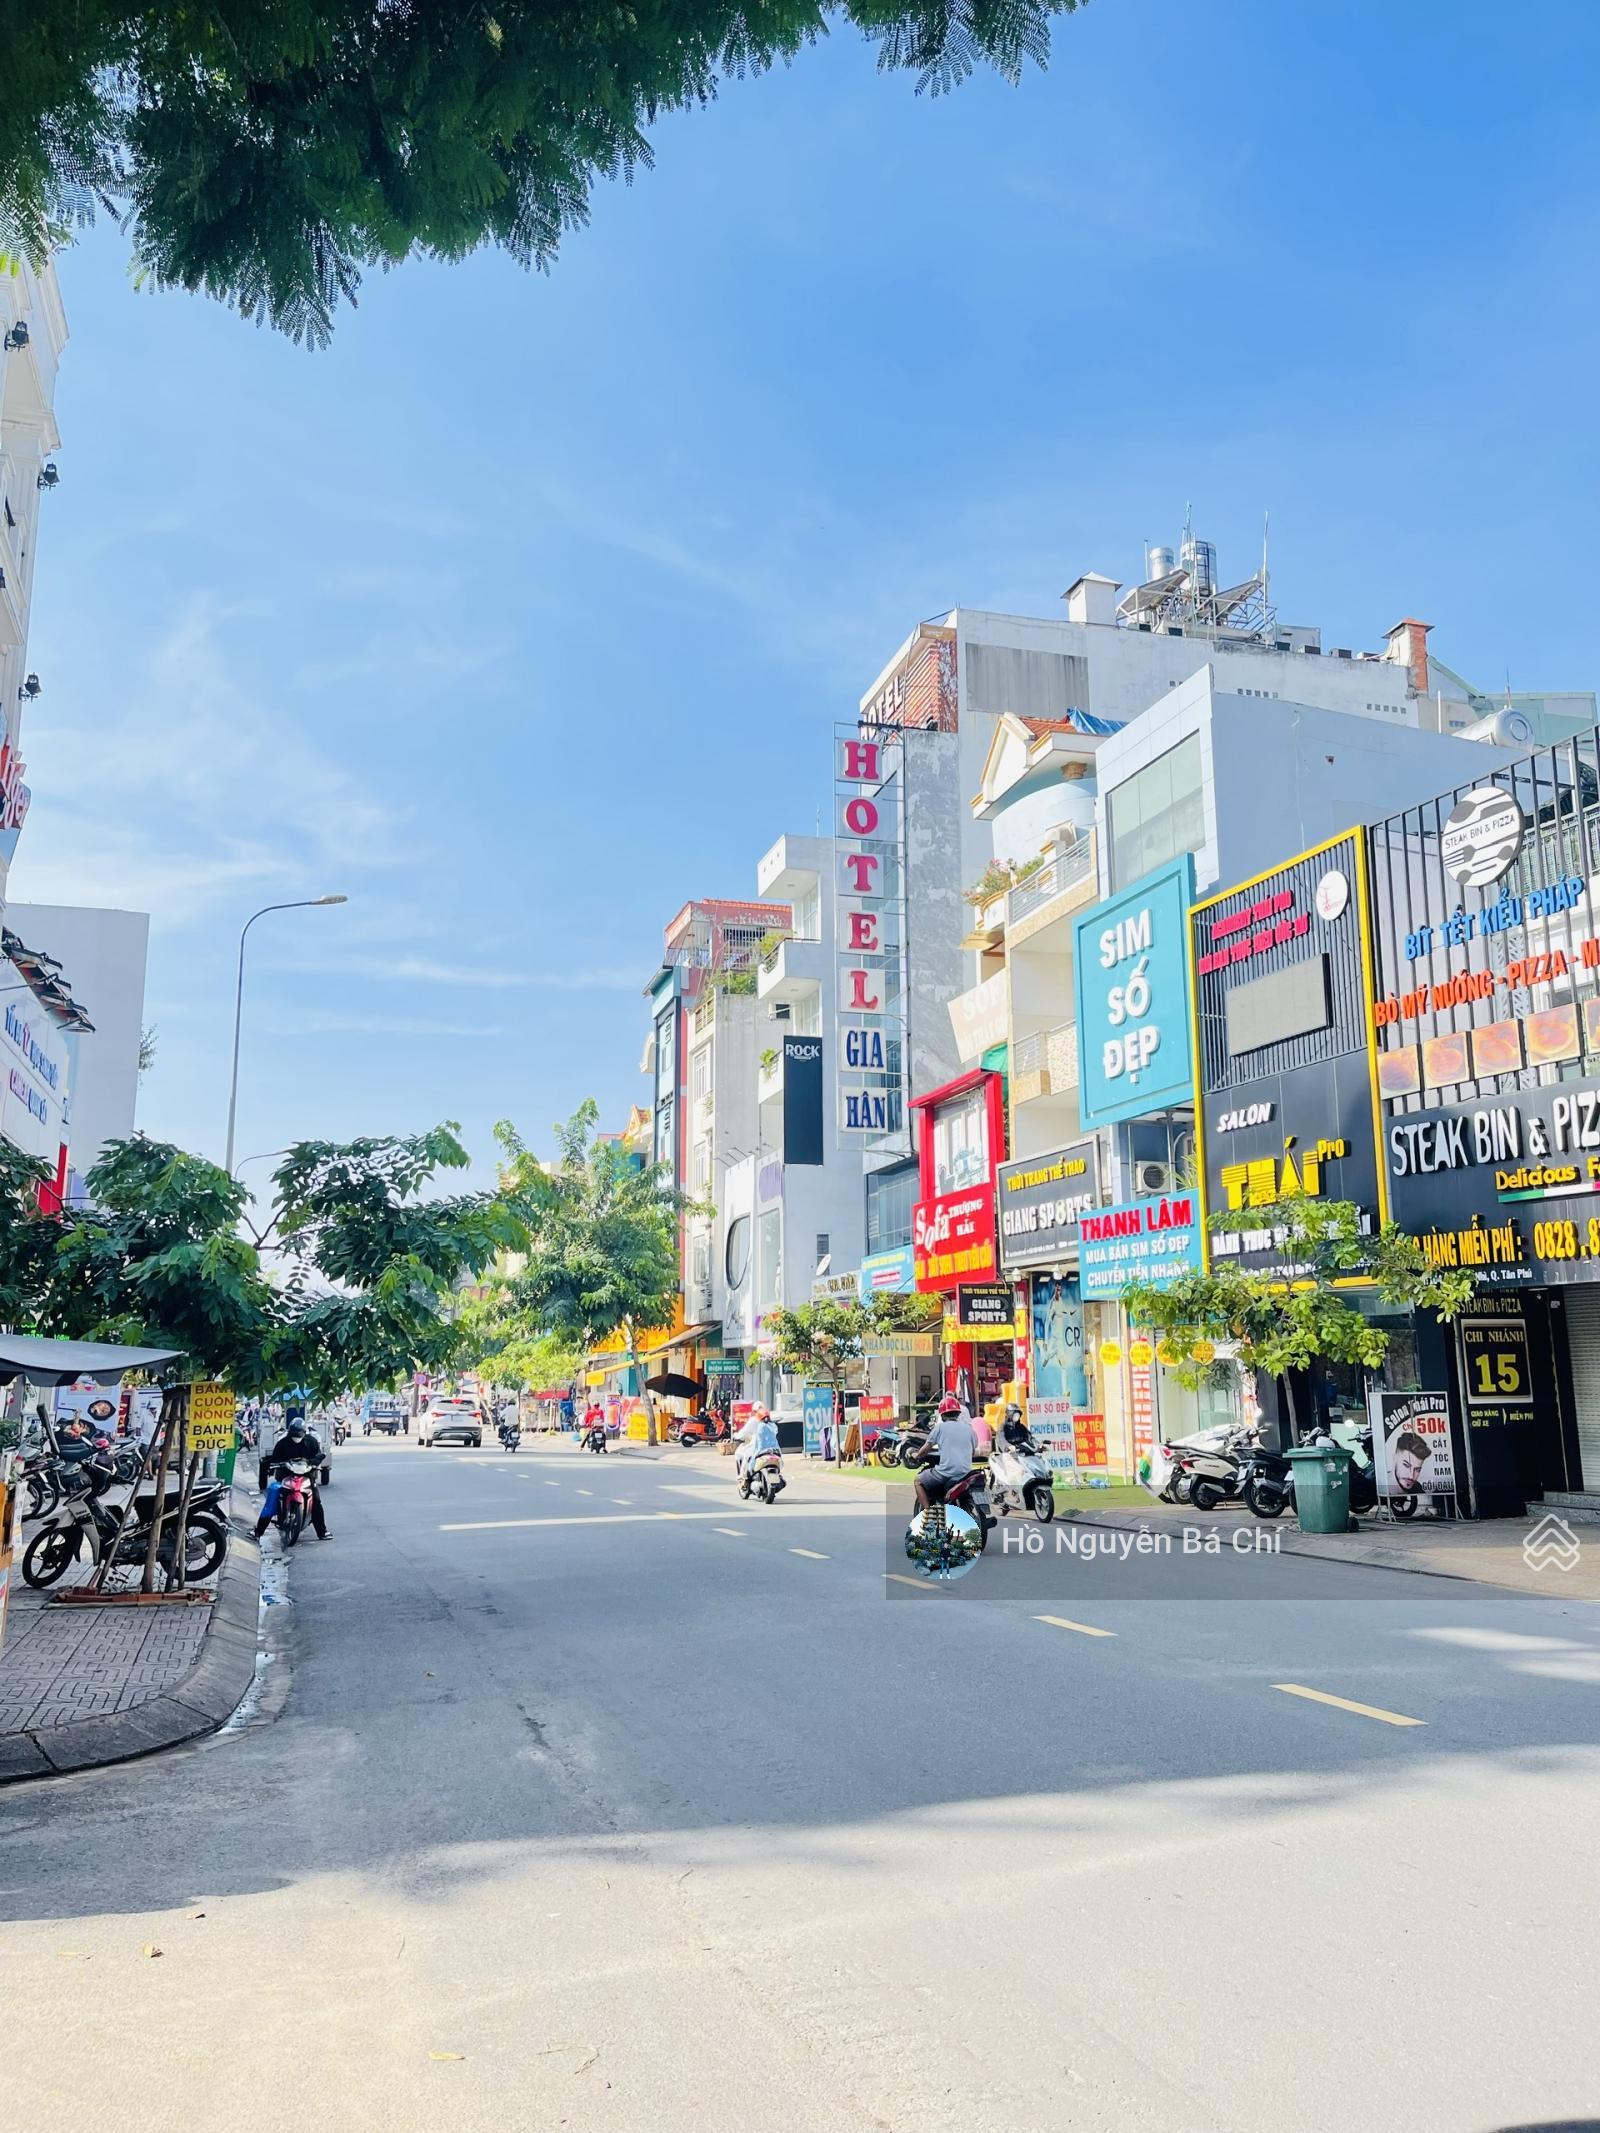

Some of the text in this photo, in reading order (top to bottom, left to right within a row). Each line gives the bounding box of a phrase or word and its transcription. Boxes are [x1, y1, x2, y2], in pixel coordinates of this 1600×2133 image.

[1445, 833, 1468, 849] STEAK
[1470, 828, 1484, 840] BIN
[1492, 814, 1516, 832] PIZZA
[844, 741, 879, 1010] HOTEL
[1404, 924, 1433, 961] BÍT
[1480, 888, 1525, 936] KIỂU
[1528, 874, 1585, 920] PHÁP
[1099, 908, 1152, 968] SIM
[1107, 955, 1151, 1025] SỐ
[1374, 992, 1399, 1027] BÒ
[1432, 968, 1494, 1012] NƯỚNG
[1507, 949, 1568, 991] PIZZA
[785, 1044, 820, 1057] ROCK
[846, 1030, 884, 1068] GIA
[1103, 1025, 1160, 1084] ĐẸP
[846, 1091, 885, 1129] HÂN
[1217, 1102, 1273, 1133] SALON
[1391, 1089, 1600, 1176] STEAK BIN & PIZ
[1024, 1167, 1048, 1188] TRANG
[1064, 1158, 1086, 1176] THAO
[1495, 1164, 1576, 1190] Delicious
[916, 1204, 951, 1251] Sofa
[1003, 1193, 1093, 1236] GIANG SPORTS
[1079, 1198, 1192, 1242] THANH LÂM
[1086, 1248, 1106, 1265] MUA
[1109, 1241, 1129, 1261] BÁN
[1130, 1241, 1149, 1258] SIM
[1151, 1231, 1166, 1255] SỐ
[1168, 1235, 1190, 1256] ĐẸP
[1422, 1226, 1457, 1267] HÀNG
[1458, 1214, 1490, 1265] MIỄN
[1501, 1269, 1516, 1279] Tân
[1517, 1267, 1532, 1279] Phú
[968, 1312, 1007, 1322] SPORTS
[972, 1299, 1001, 1309] GIANG
[1460, 1298, 1483, 1313] STEAK
[1484, 1298, 1495, 1313] BIN
[1501, 1298, 1522, 1313] PIZZA
[1465, 1328, 1525, 1343] CHI NHÁNH
[1475, 1354, 1520, 1392] 15
[193, 1408, 233, 1420] NÓNG
[1029, 1403, 1041, 1414] SIM
[1384, 1404, 1409, 1430] Salon
[1430, 1397, 1444, 1410] Pro
[193, 1422, 233, 1435] BÁNH
[1417, 1417, 1446, 1434] 50k
[196, 1437, 226, 1449] ĐÚC
[1434, 1468, 1451, 1476] NAM
